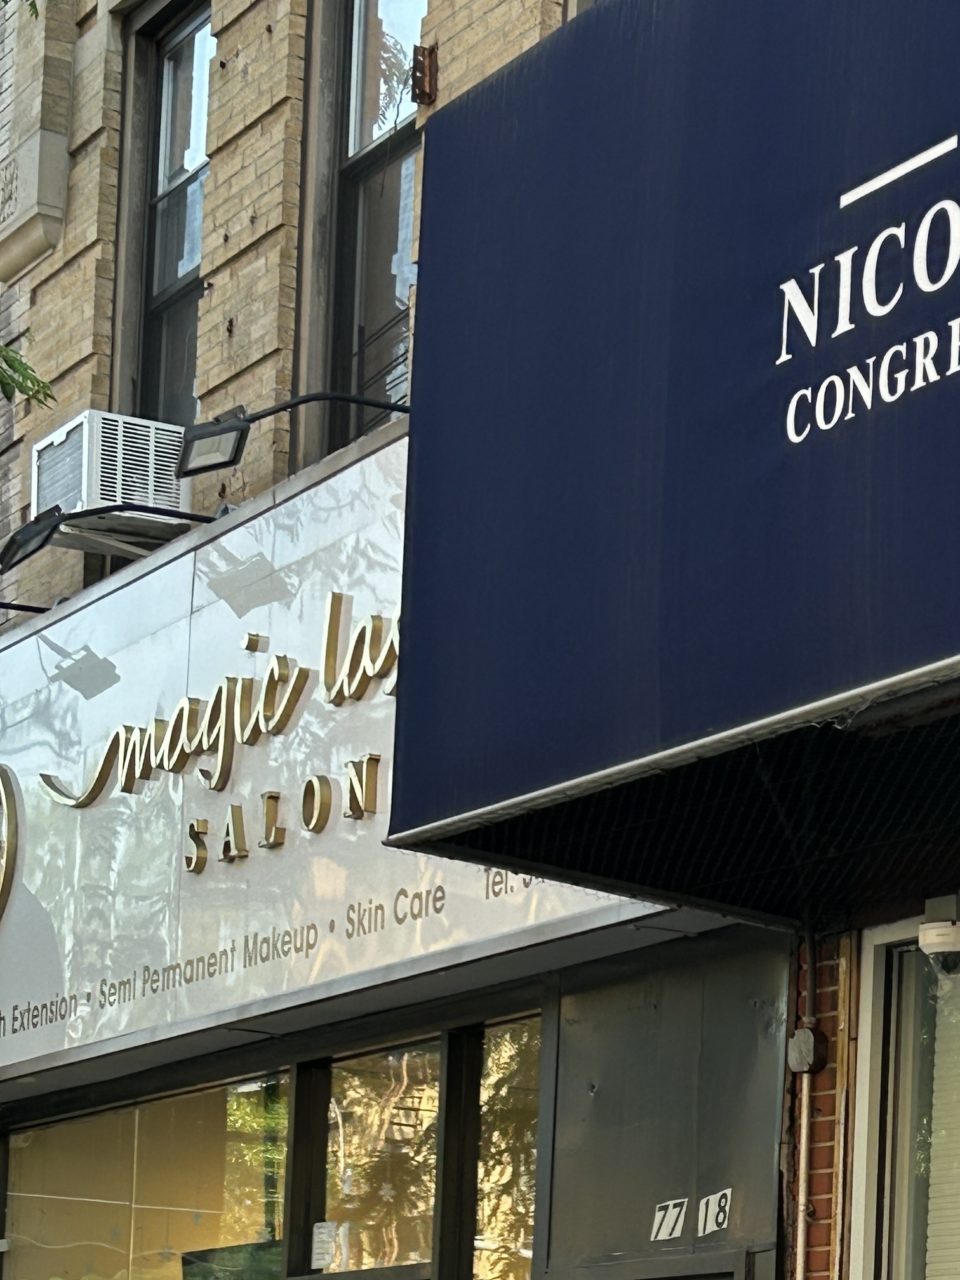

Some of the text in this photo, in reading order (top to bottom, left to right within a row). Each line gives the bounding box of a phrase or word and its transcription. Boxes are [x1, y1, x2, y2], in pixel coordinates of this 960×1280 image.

[39, 632, 310, 808] magic
[185, 752, 381, 874] SALON
[12, 992, 77, 1034] Extension
[99, 970, 136, 1010] Semi
[142, 946, 236, 998] Permanent
[243, 921, 318, 969] Makeup
[345, 899, 385, 940] Skin
[393, 885, 446, 925] Care
[484, 866, 514, 900] Tel.
